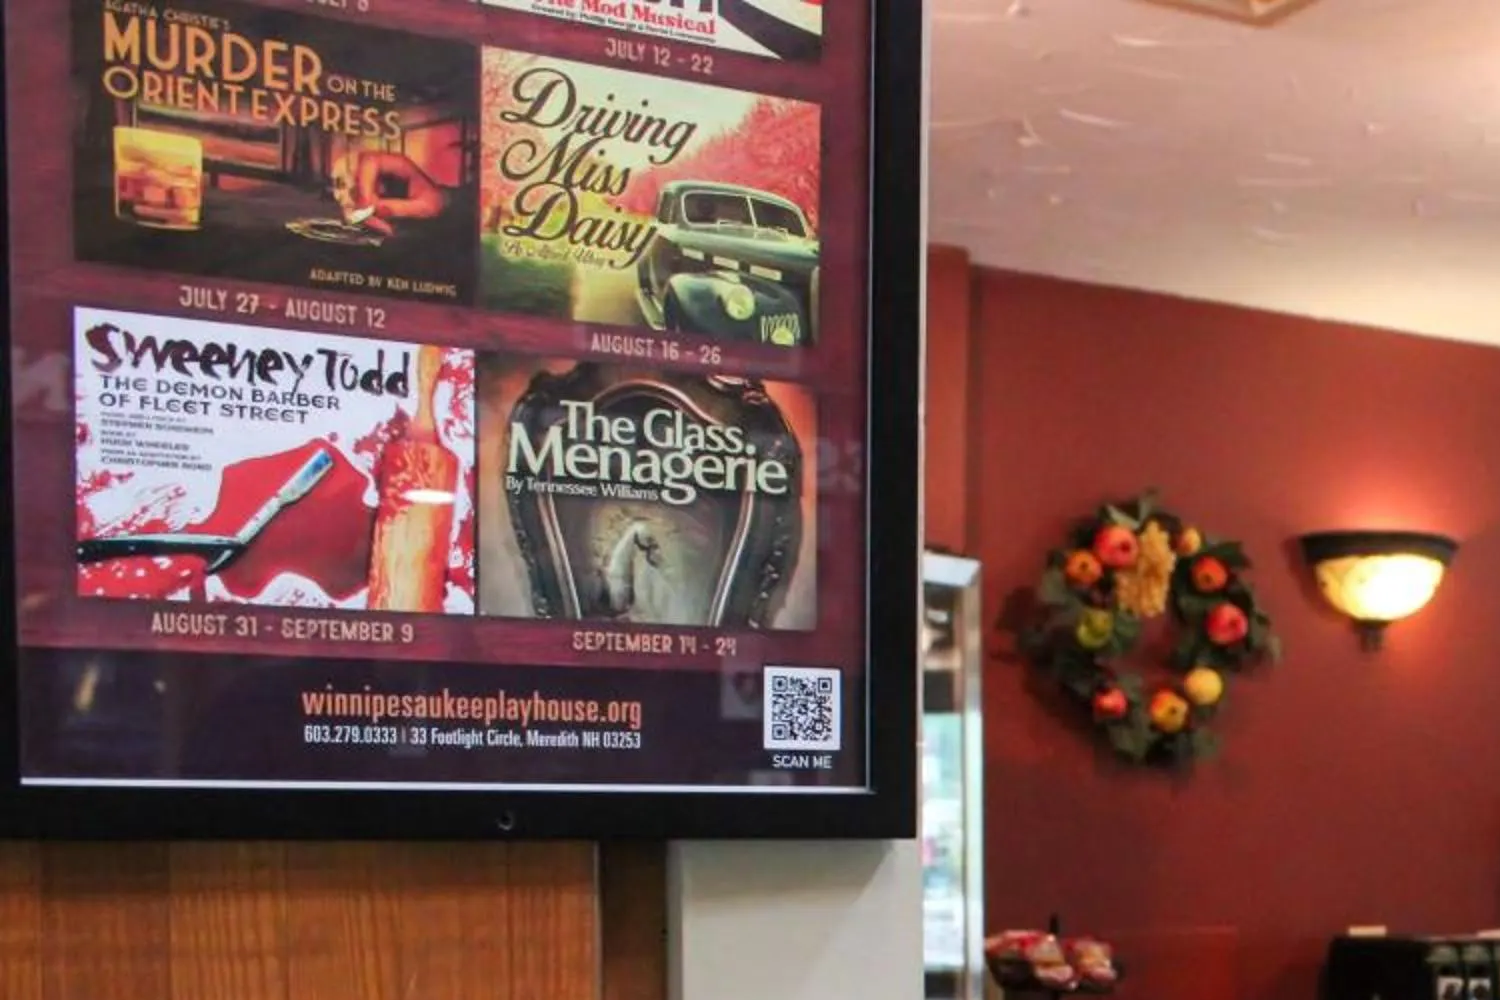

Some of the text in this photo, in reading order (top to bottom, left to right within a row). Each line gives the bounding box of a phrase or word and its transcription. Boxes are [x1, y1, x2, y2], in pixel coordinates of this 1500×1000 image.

[582, 0, 626, 19] Mod
[632, 3, 716, 35] Musical
[104, 12, 396, 102] MURDER ON THE
[606, 38, 646, 62] JULY
[654, 46, 671, 67] 12
[691, 55, 713, 74] 22
[103, 66, 401, 139] ORIENT EXPRESS
[500, 67, 698, 163] Driving
[500, 135, 632, 197] Miss
[502, 181, 658, 270] Daisy
[180, 286, 227, 312] JULY
[237, 294, 259, 315] 27
[285, 297, 357, 325] AUGUST
[365, 308, 386, 328] 12
[85, 323, 411, 399] Sweeney Todd
[591, 335, 655, 359] AUGUST
[661, 341, 679, 360] 16
[700, 344, 721, 364] 26
[100, 393, 309, 424] OF FLEET STREET
[101, 375, 340, 411] THE DEMON BARBER
[560, 400, 744, 454] The Glass
[507, 422, 788, 505] Menagerie
[506, 475, 658, 500] By Tennessee Williams
[152, 612, 228, 636] AUGUST
[236, 616, 258, 637] 31
[281, 617, 393, 642] SEPTEMBER
[400, 623, 414, 643] 9
[572, 631, 673, 655] SEPTEMBER
[680, 635, 697, 655] 14
[716, 637, 737, 656] 24
[301, 684, 642, 730] winnipesaukeeplayhouse.org
[304, 725, 397, 744] 603.279.0333
[410, 727, 427, 744] 33
[431, 726, 484, 748] Footlight
[527, 729, 579, 748] Meredith
[582, 731, 600, 748] NH
[603, 731, 641, 749] 03253
[772, 754, 832, 769] SCAN ME
